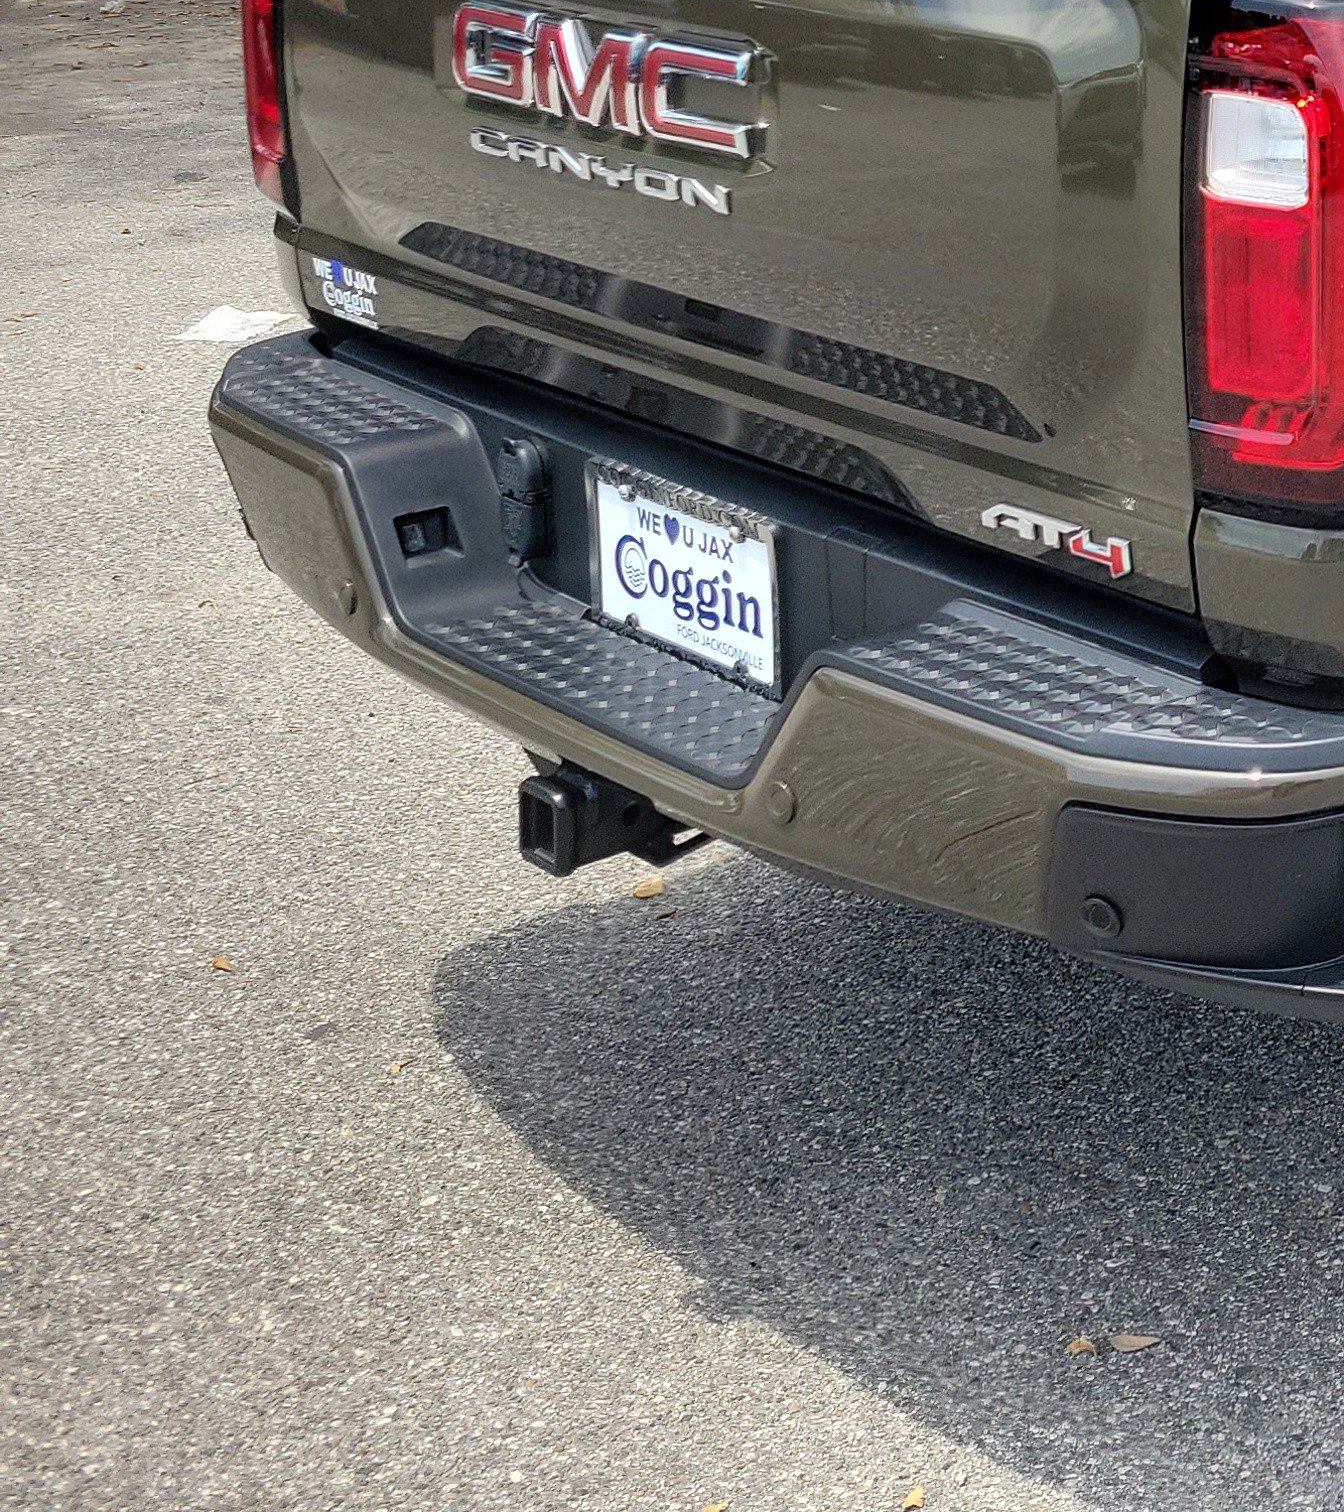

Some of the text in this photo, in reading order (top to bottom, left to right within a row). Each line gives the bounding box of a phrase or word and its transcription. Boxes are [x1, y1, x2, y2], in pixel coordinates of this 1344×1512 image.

[470, 125, 732, 216] CANYON
[312, 257, 378, 295] WE U JAX
[323, 280, 376, 316] Coggin
[636, 506, 734, 564] WE U JAX
[981, 503, 1133, 579] AT4
[614, 534, 764, 639] Coggin
[677, 623, 764, 671] FORD JACKSONVILLE
